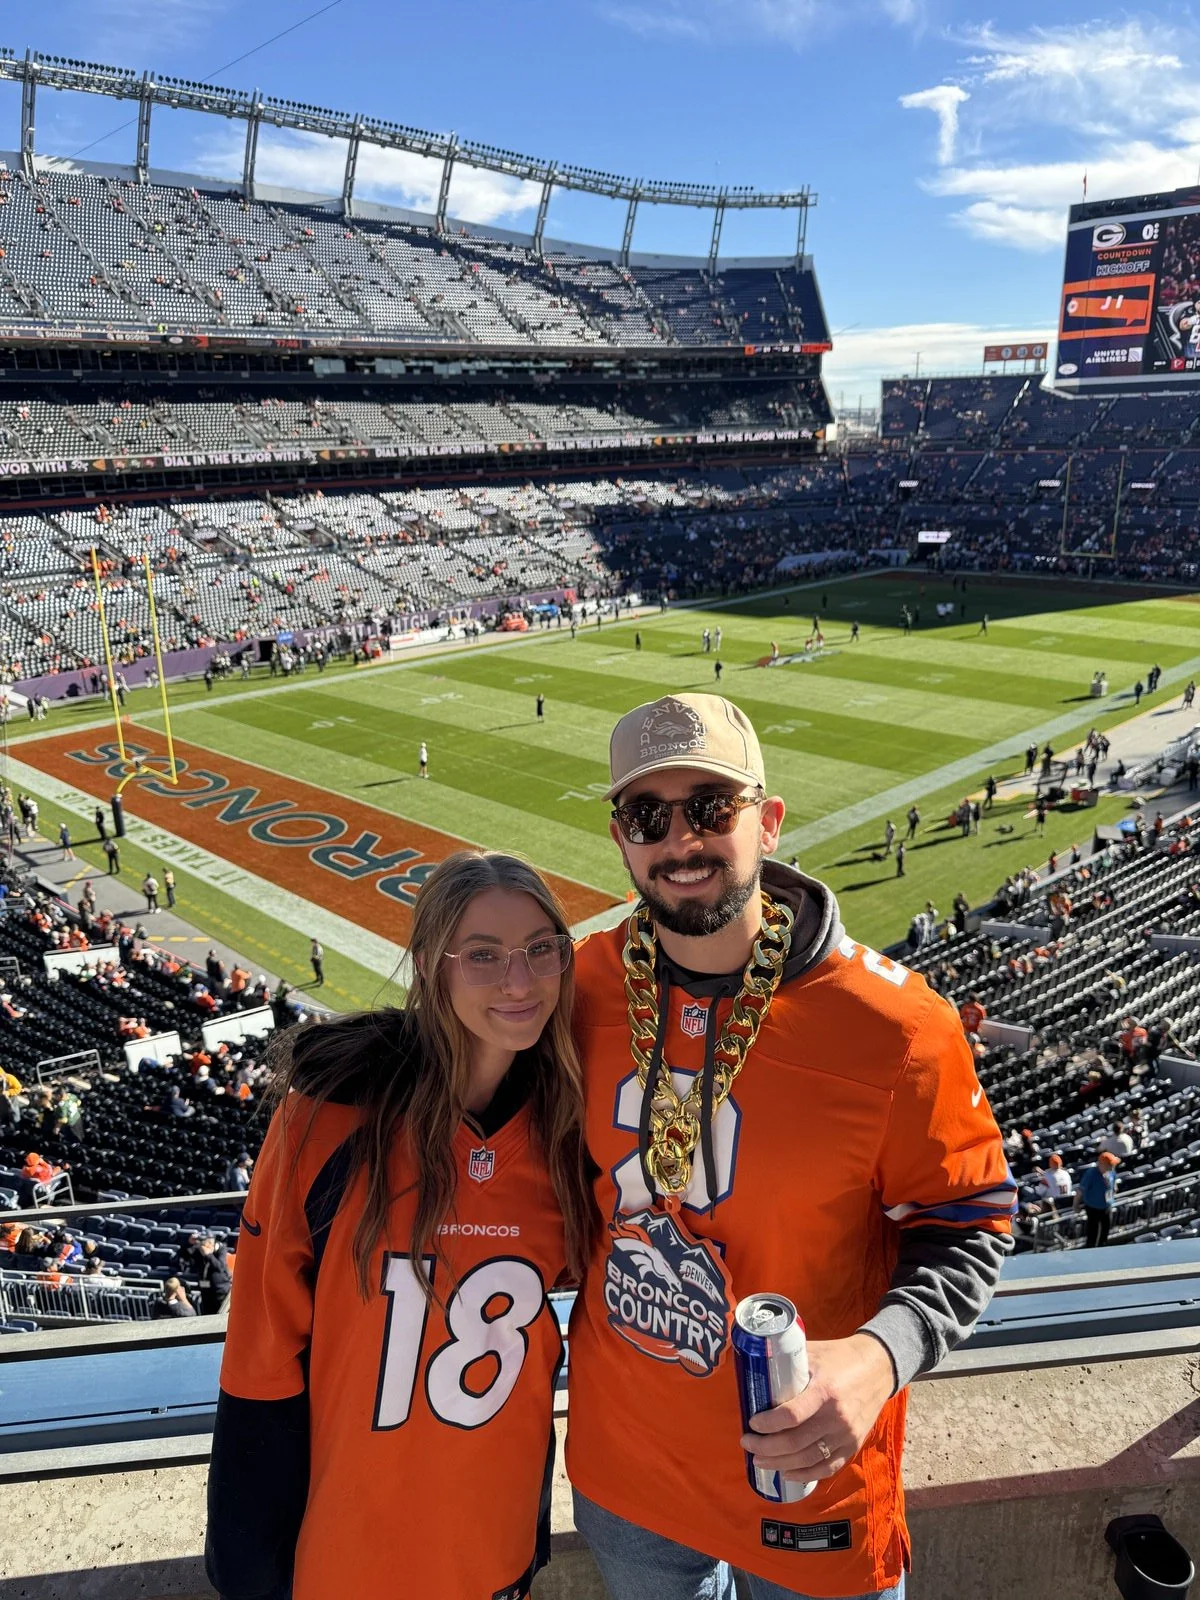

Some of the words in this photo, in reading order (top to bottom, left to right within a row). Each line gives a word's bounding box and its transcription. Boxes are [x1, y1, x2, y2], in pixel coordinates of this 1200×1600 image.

[1097, 248, 1152, 260] COUNTDOWN
[1096, 260, 1150, 276] KICKOFF
[1085, 355, 1127, 364] AIRLINES
[744, 431, 775, 441] FLAVOR
[776, 430, 799, 440] WITH
[32, 461, 67, 473] WITH
[163, 456, 191, 467] DIAL
[193, 455, 206, 465] IN
[208, 454, 230, 465] THE
[232, 452, 271, 463] FLAVOR
[273, 450, 300, 461] WITH
[390, 613, 429, 635] HIGH
[641, 702, 707, 746] DENVER
[641, 739, 707, 758] BRONCOS
[64, 742, 442, 908] BRONCOS
[684, 1017, 703, 1032] NFL
[472, 1161, 490, 1176] NFL
[437, 1223, 520, 1237] BRONCOS
[685, 1264, 714, 1295] DENVER
[606, 1258, 724, 1337] BRONCOS
[604, 1280, 722, 1363] COUNTRY
[371, 1251, 546, 1432] 18
